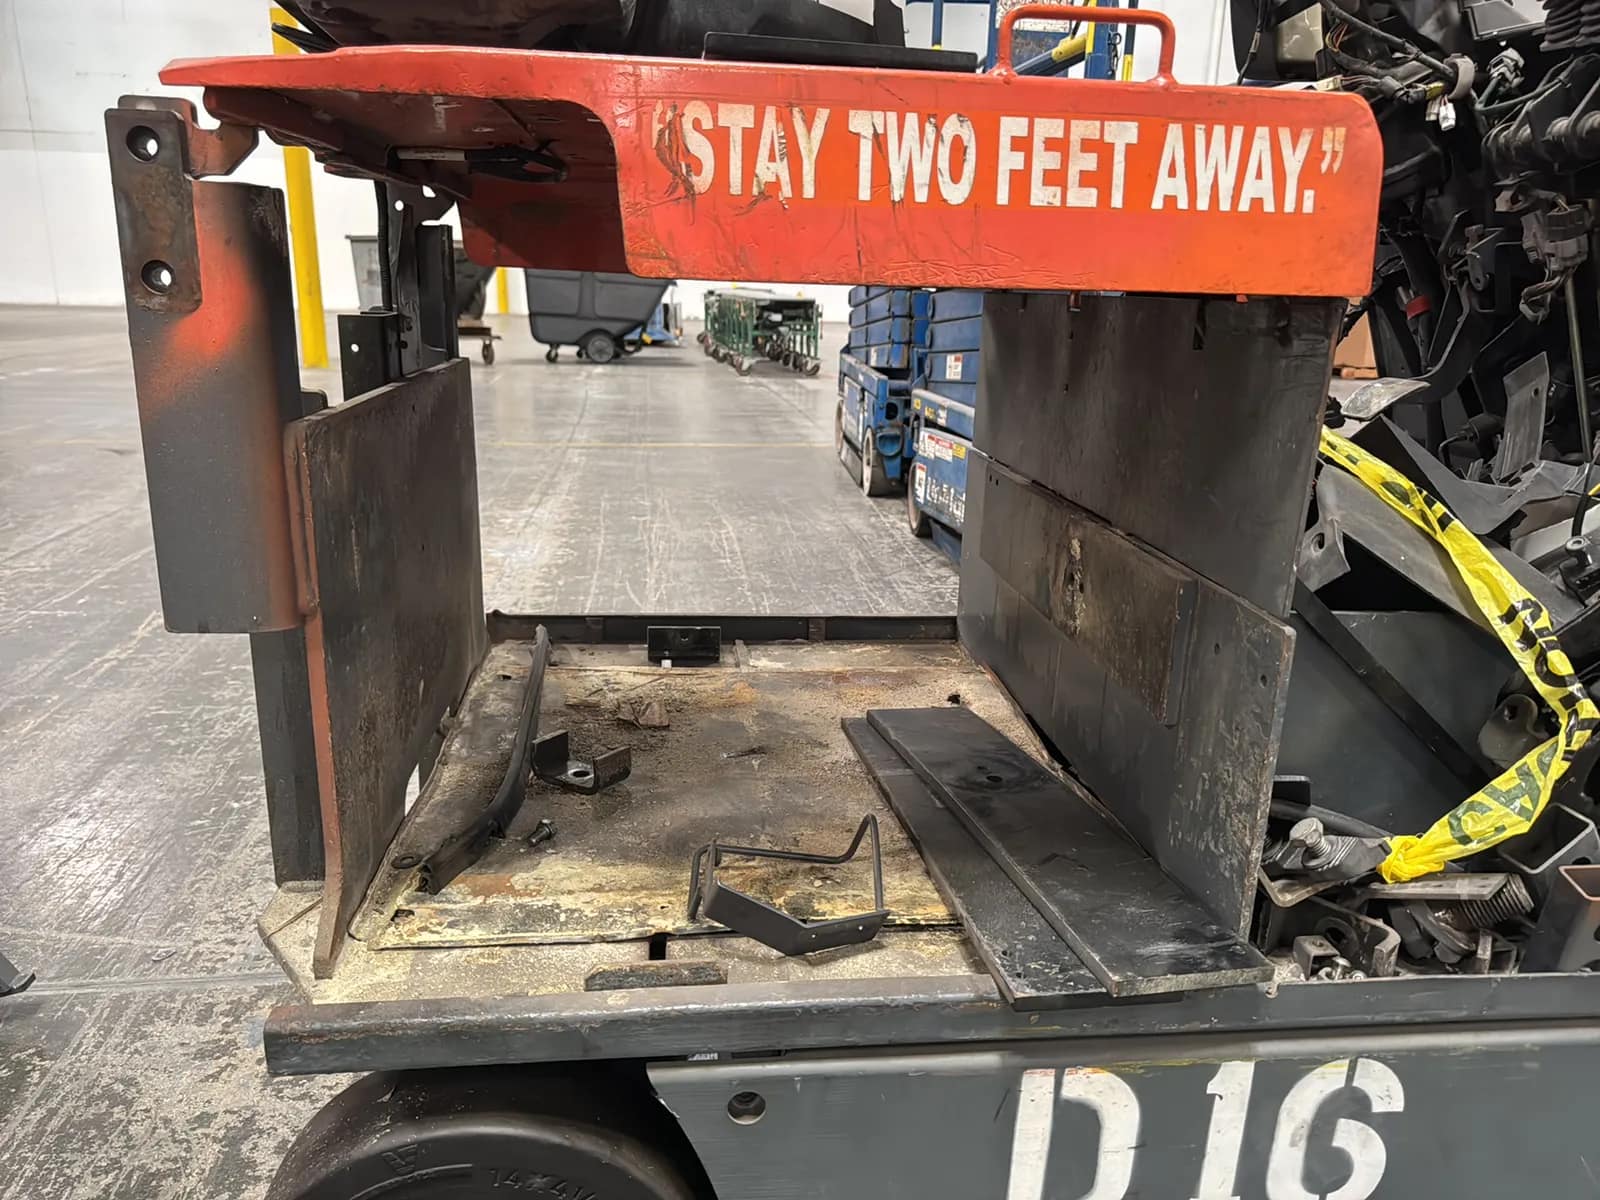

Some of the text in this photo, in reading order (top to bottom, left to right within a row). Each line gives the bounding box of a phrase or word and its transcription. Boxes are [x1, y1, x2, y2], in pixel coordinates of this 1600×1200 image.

[848, 109, 977, 206] TWO
[996, 116, 1139, 209] FEET
[1150, 123, 1347, 214] AWAY.”
[1006, 1057, 1405, 1200] D 16
